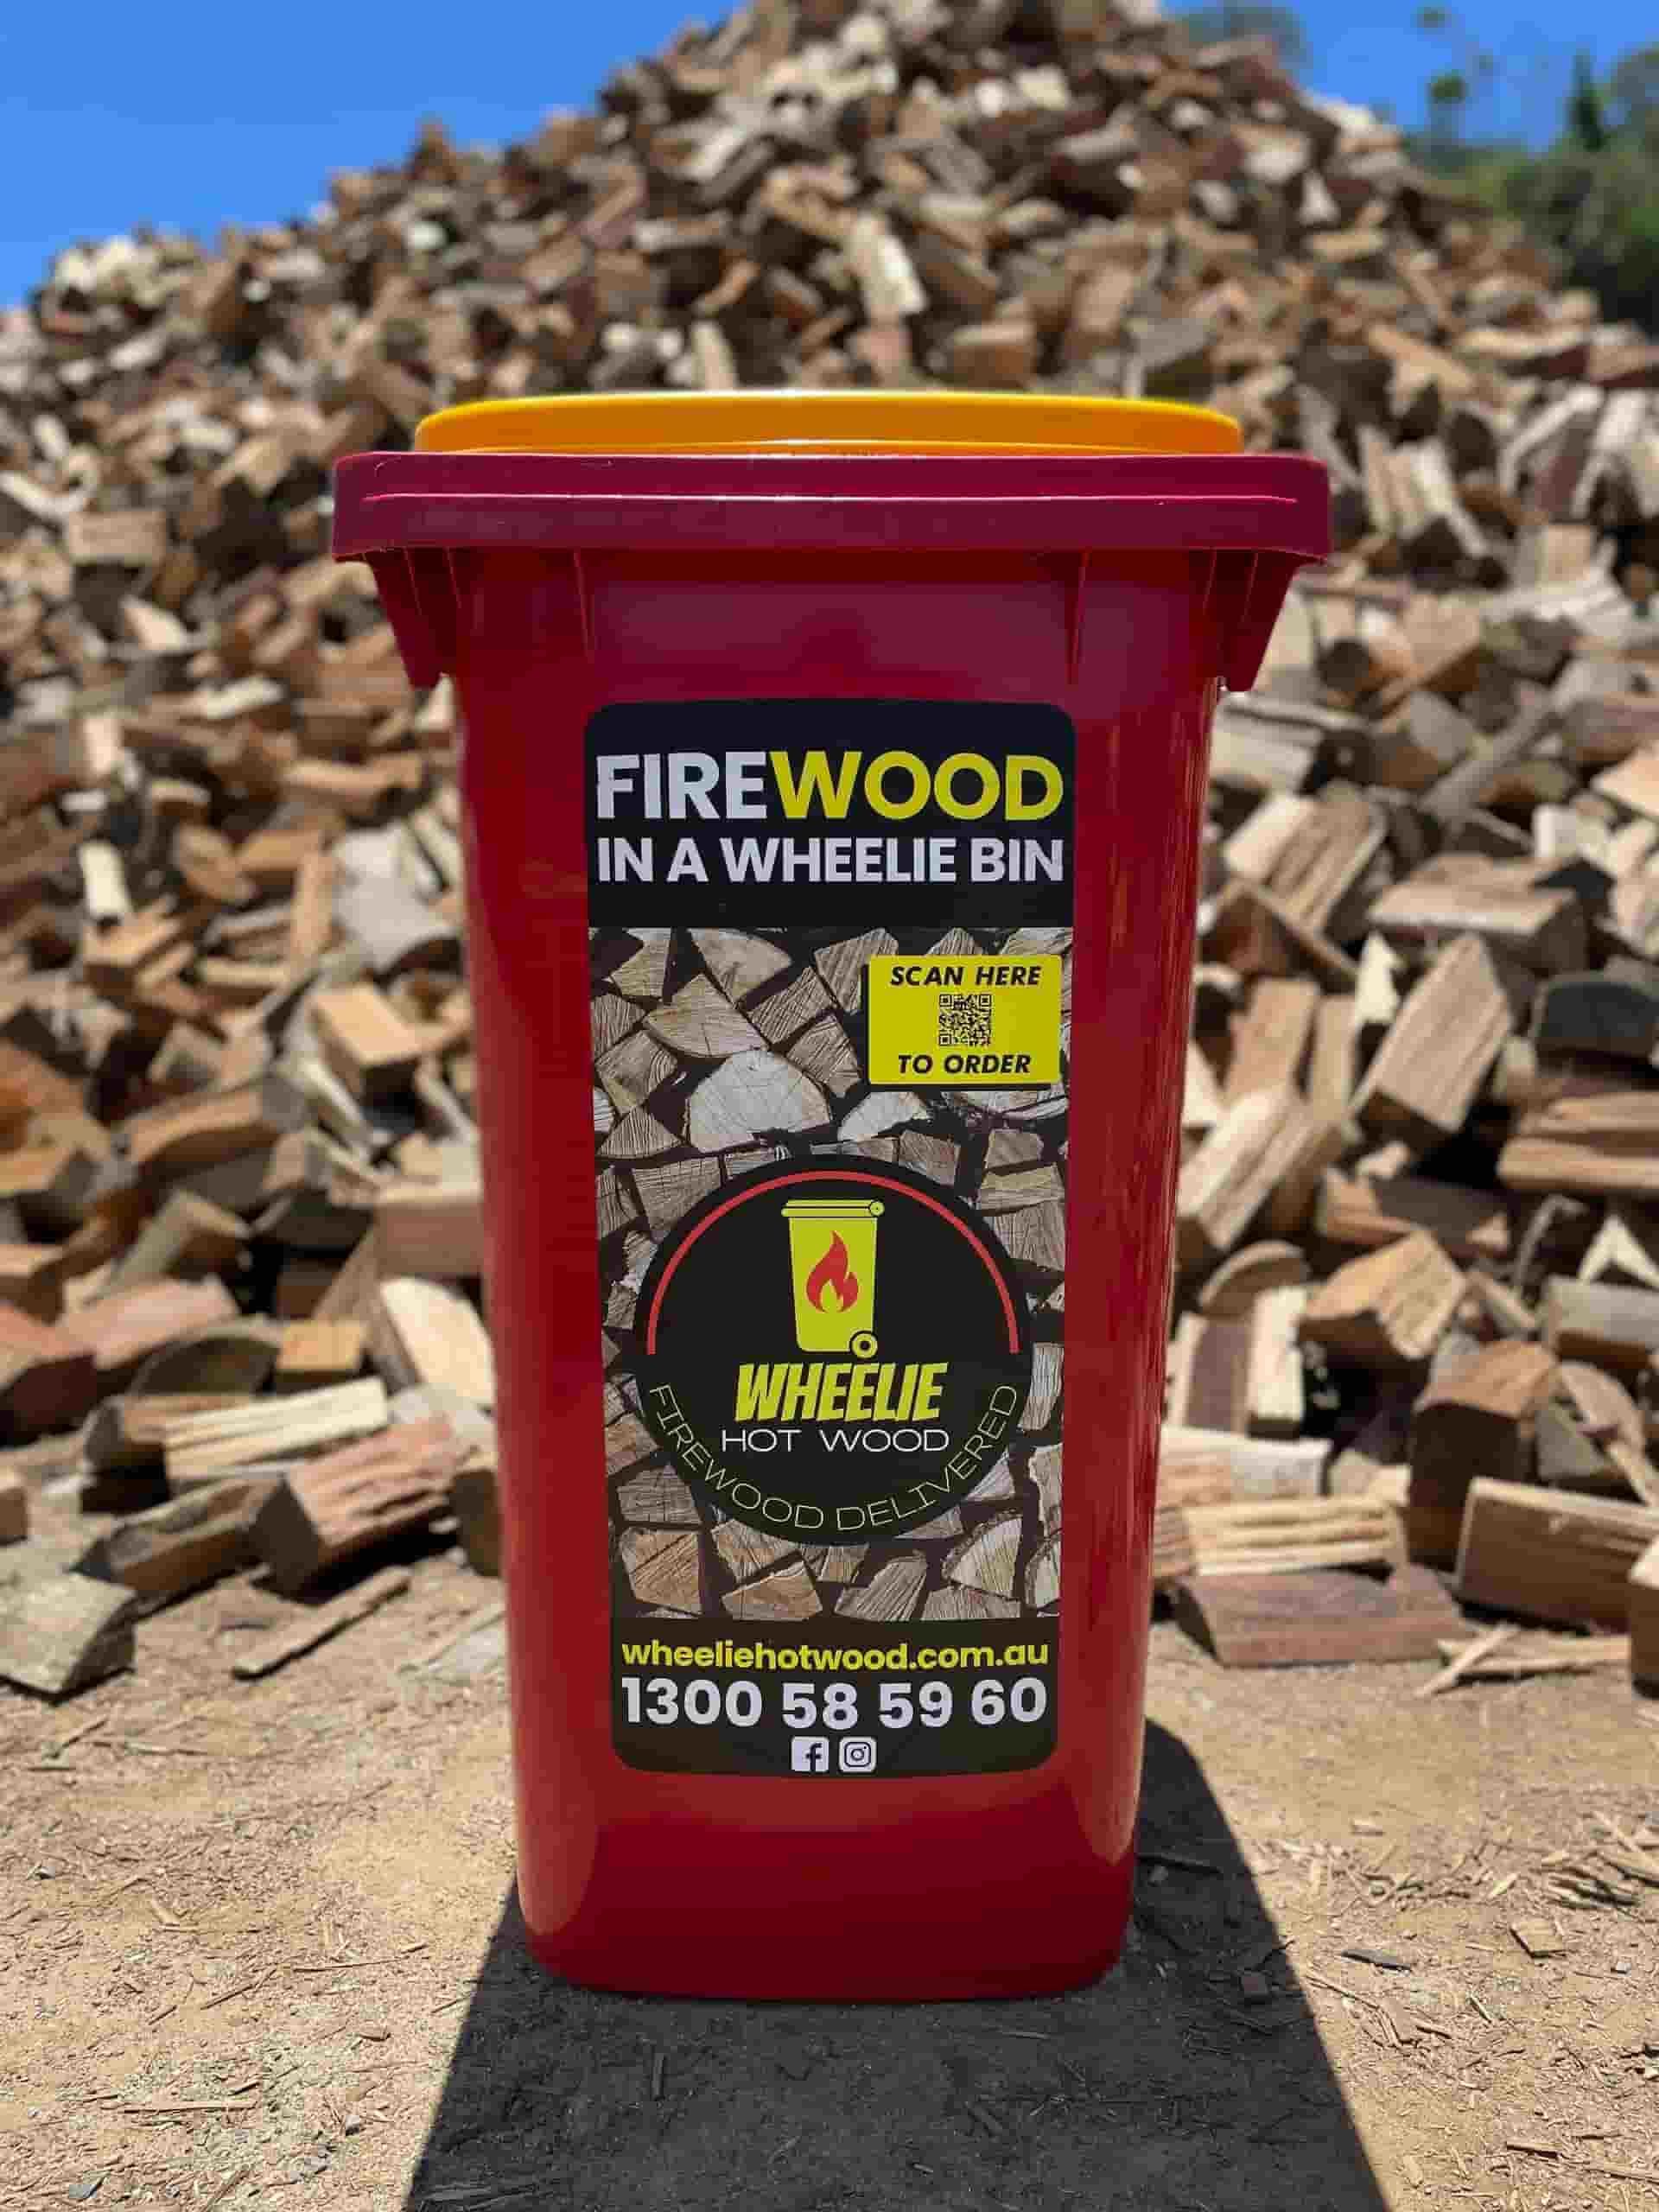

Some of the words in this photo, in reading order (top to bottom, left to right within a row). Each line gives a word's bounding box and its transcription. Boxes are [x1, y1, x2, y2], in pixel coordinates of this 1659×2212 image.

[596, 750, 1064, 820] FIREWOOD
[597, 836, 652, 884] IN
[667, 837, 709, 883] A
[720, 836, 957, 884] WHEELIE
[969, 836, 1064, 883] BIN
[890, 965, 963, 988] SCAN
[975, 965, 1041, 987] HERE
[899, 1054, 933, 1074] TO
[944, 1054, 1031, 1074] ORDER
[734, 1361, 949, 1422] WHEELIE
[650, 1384, 823, 1529] FIREWOOD
[836, 1386, 1017, 1531] DELIVERED
[721, 1428, 802, 1452] HOT
[818, 1428, 950, 1452] WOOD
[622, 1640, 1049, 1670] wheeliehotwood.com.au
[622, 1677, 762, 1727] 1300
[781, 1682, 858, 1730] 58
[879, 1681, 954, 1729] 59
[970, 1677, 1047, 1726] 60
